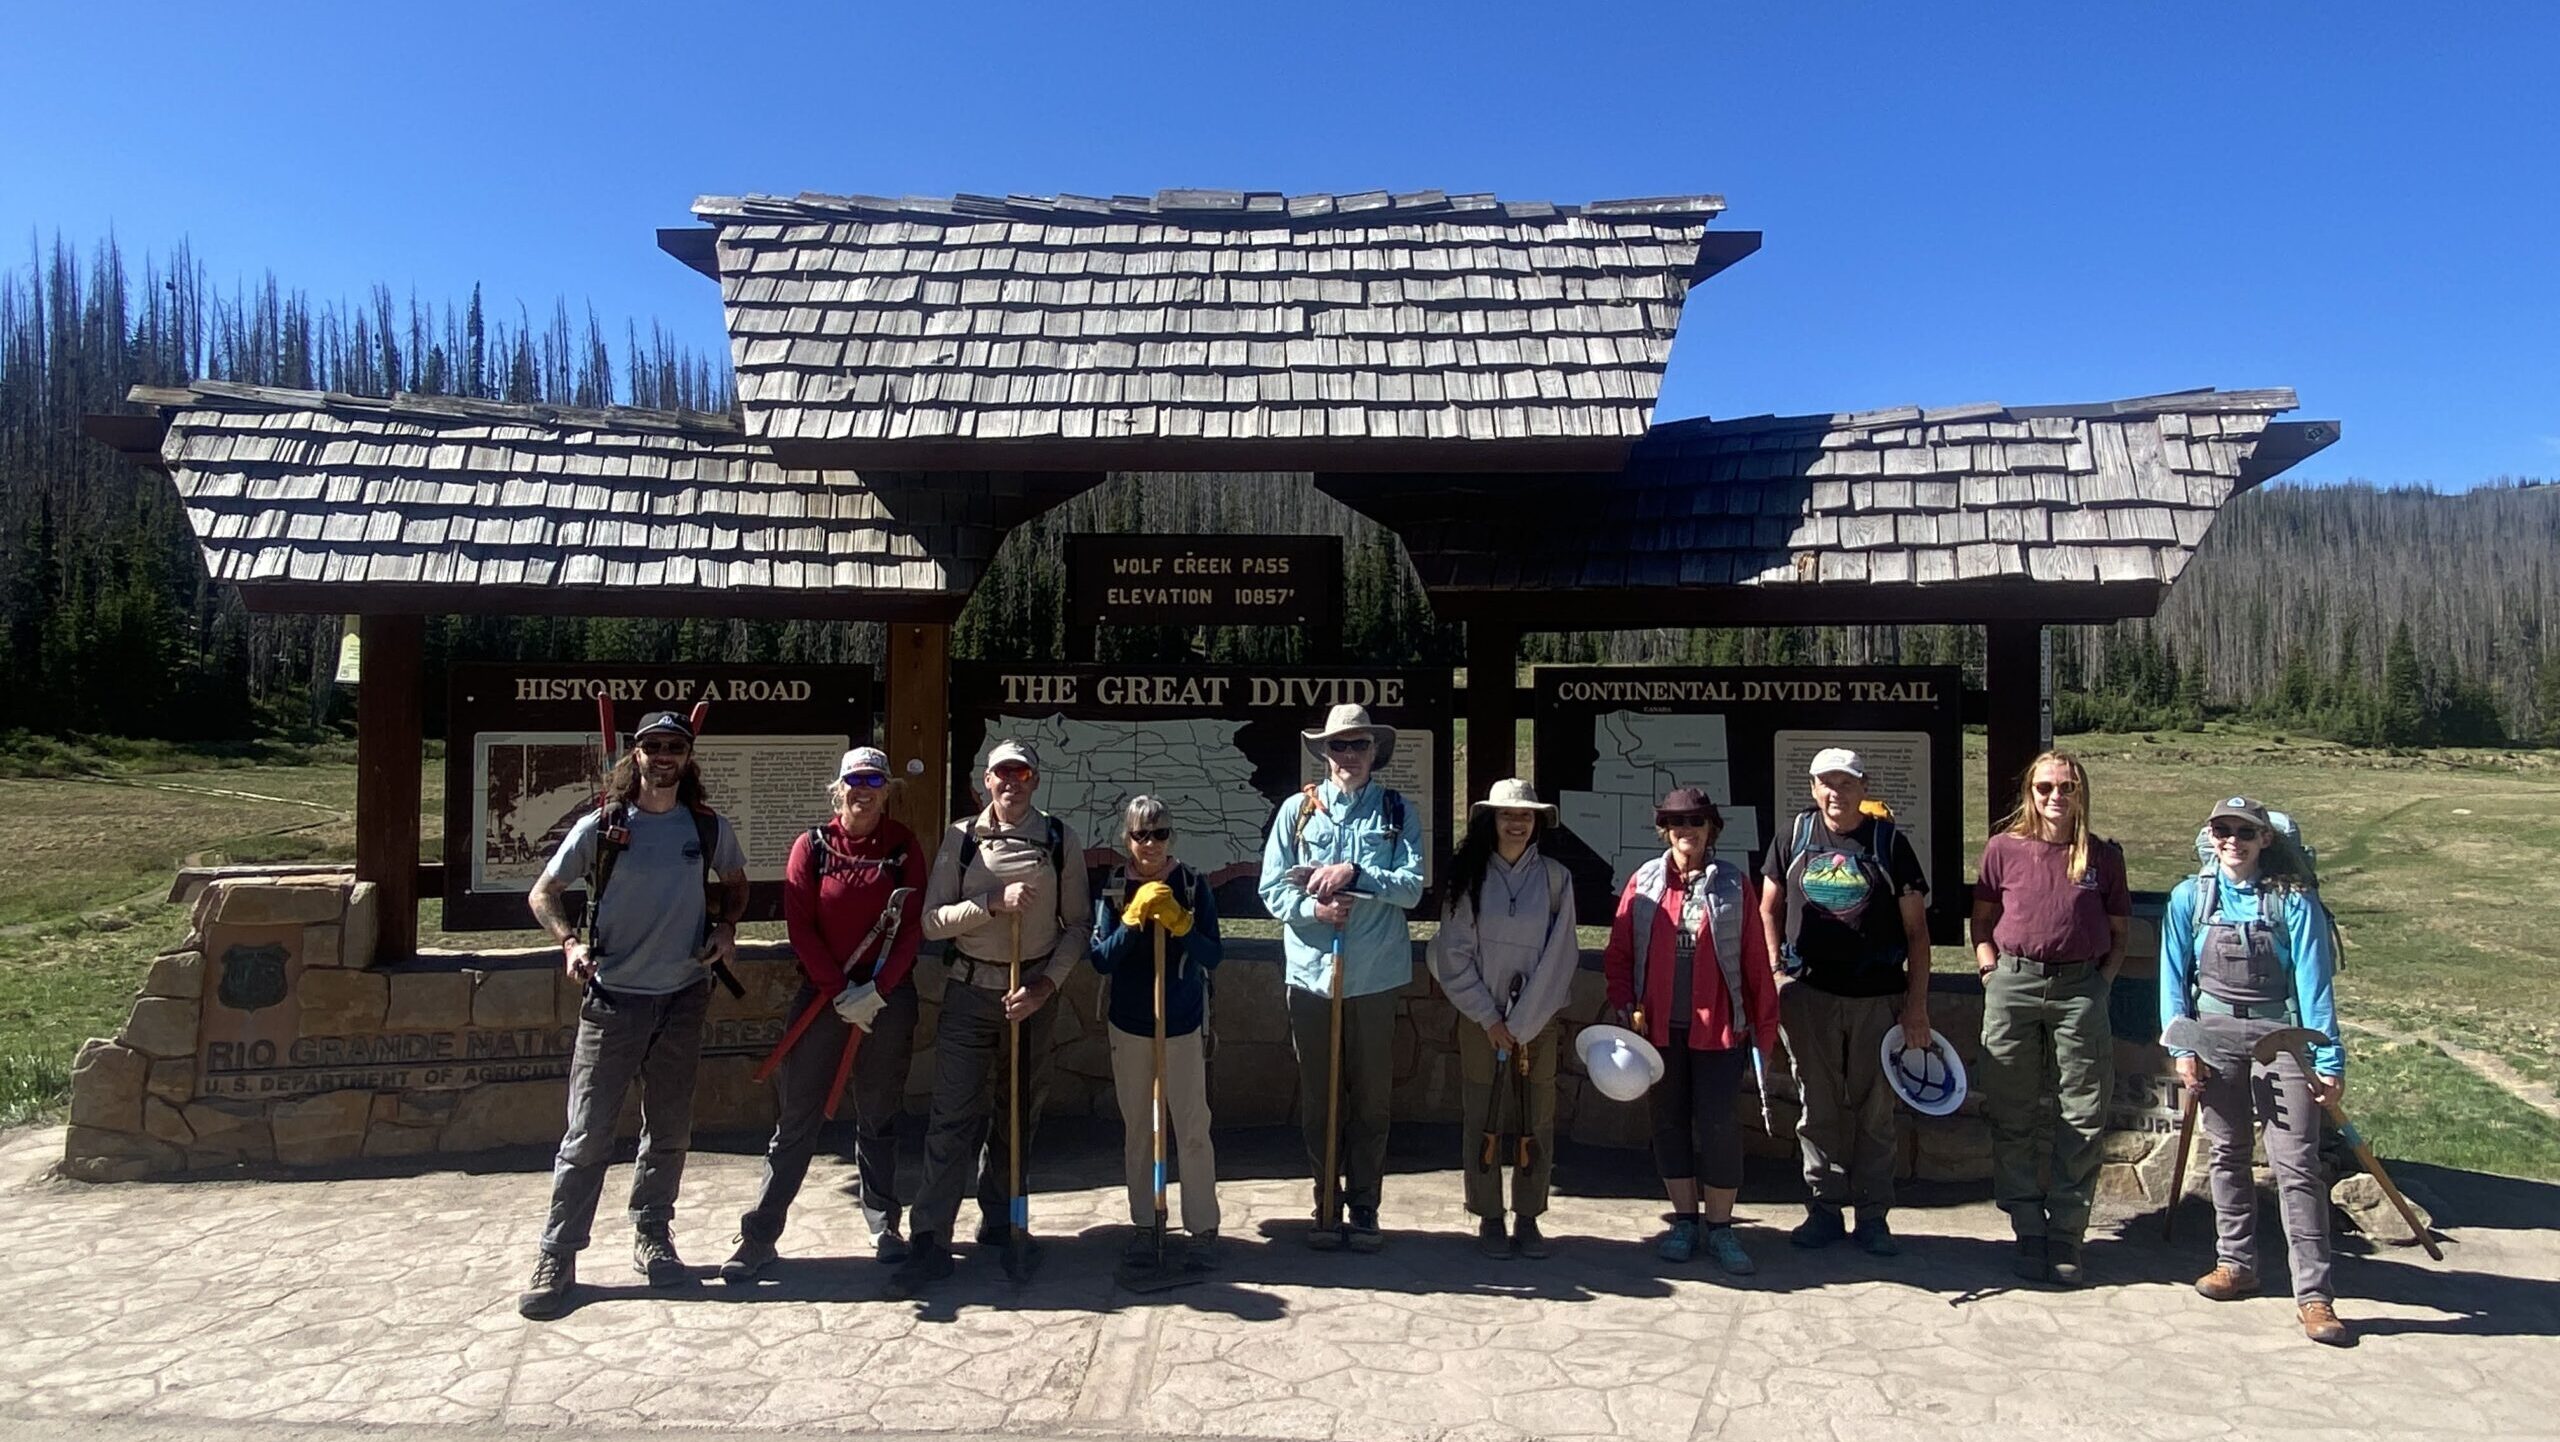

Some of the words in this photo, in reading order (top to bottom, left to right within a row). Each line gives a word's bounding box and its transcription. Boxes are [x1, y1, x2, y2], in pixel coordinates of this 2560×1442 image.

[1113, 557, 1163, 575] WOLF
[1173, 557, 1232, 574] CREEK
[1242, 557, 1290, 574] PASS
[1107, 588, 1212, 605] ELEVATION
[515, 678, 647, 701] HISTORY
[655, 679, 696, 701] OF
[702, 680, 722, 701] A
[728, 680, 811, 701] ROAD
[1000, 675, 1077, 704] THE
[1097, 676, 1230, 706] GREAT
[1248, 677, 1404, 707] DIVIDE
[1558, 681, 1737, 701] CONTINENTAL
[1742, 681, 1841, 702] DIVIDE
[1848, 681, 1938, 702] TRAIL
[207, 1039, 277, 1071] RIO
[289, 1032, 456, 1067] GRANDE
[466, 1025, 576, 1060] NATIO
[261, 1070, 411, 1092] DEPARTMENT
[424, 1067, 455, 1084] OF
